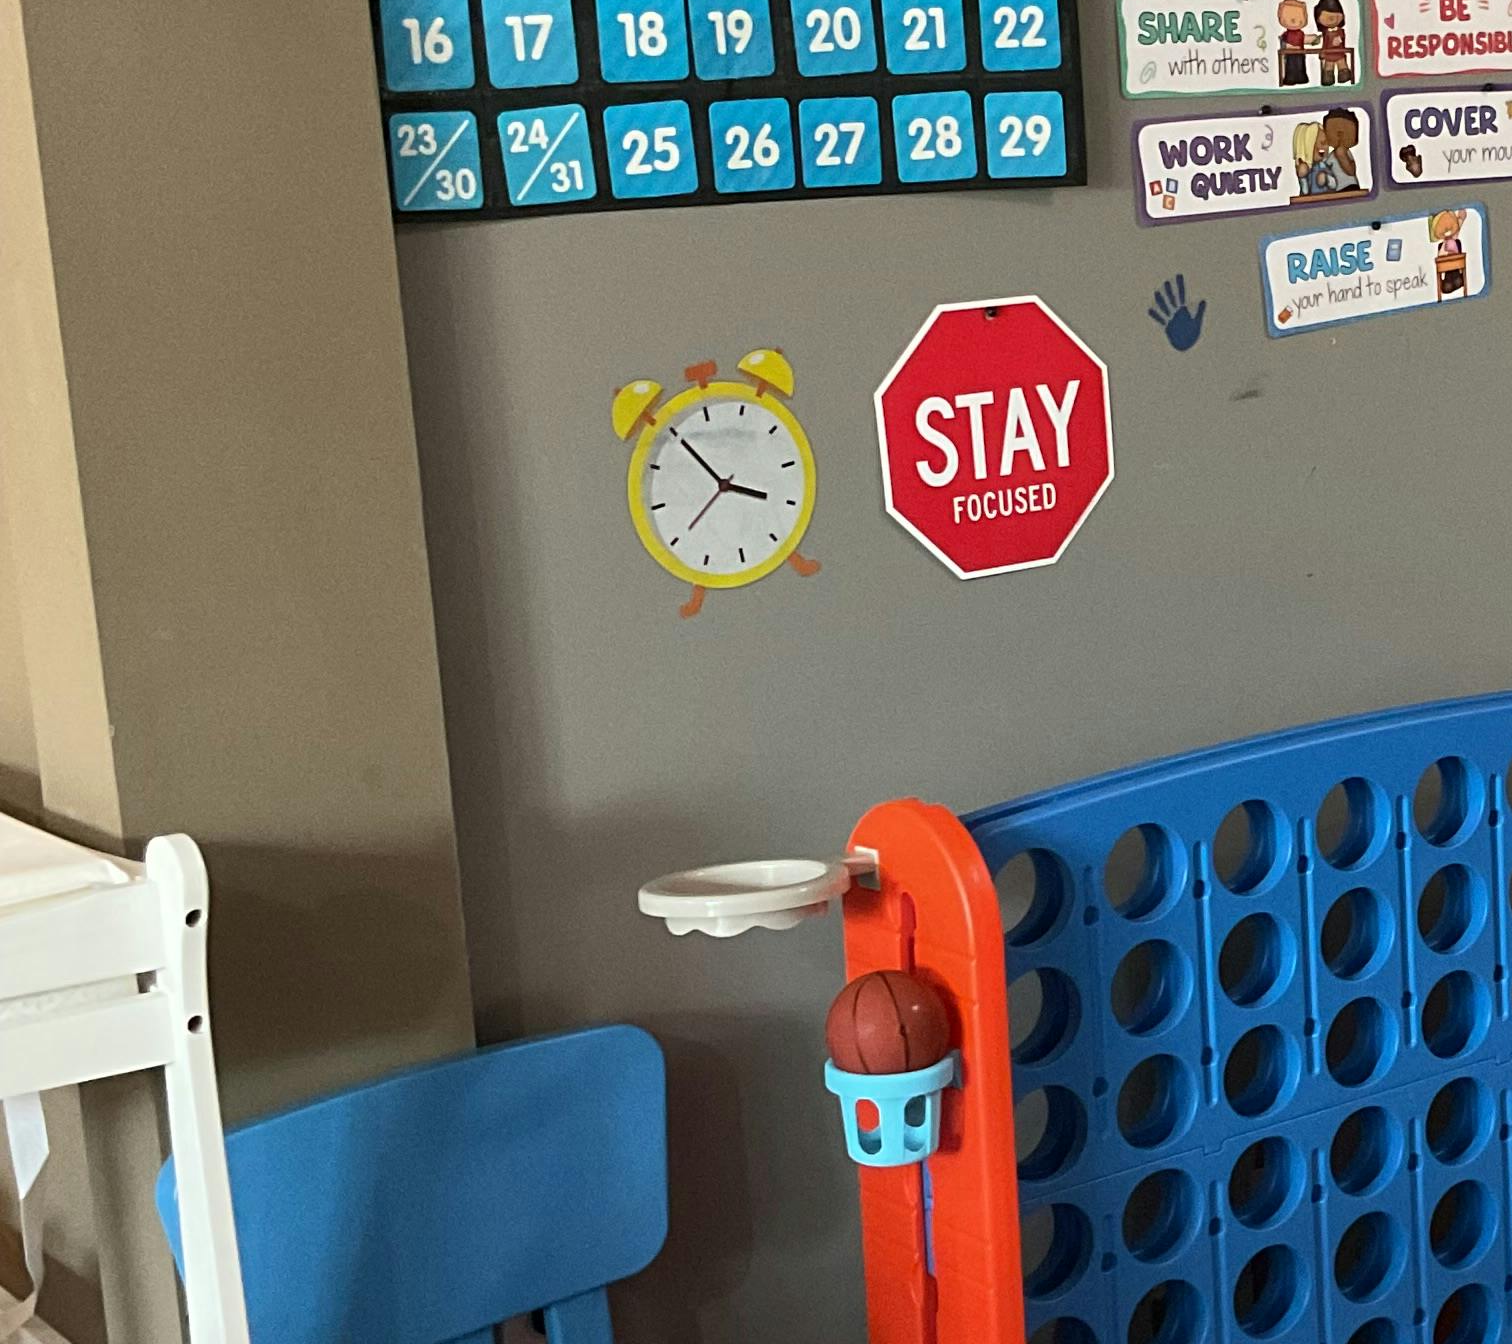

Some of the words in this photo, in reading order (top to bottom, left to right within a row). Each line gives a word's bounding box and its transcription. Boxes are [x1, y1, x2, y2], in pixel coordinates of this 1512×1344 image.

[402, 17, 454, 65] 16
[505, 14, 553, 62] 17
[617, 11, 668, 58] 18
[707, 9, 753, 55] 19
[805, 6, 862, 54] 20
[902, 7, 947, 52] 21
[992, 5, 1047, 49] 22
[1137, 10, 1243, 45] SHARE
[1167, 50, 1207, 76] with
[1211, 49, 1269, 76] others
[1404, 105, 1498, 138] COVER
[621, 126, 681, 176] 25
[724, 123, 780, 170] 26
[813, 121, 866, 167] 27
[907, 115, 962, 162] 28
[999, 115, 1052, 159] 29
[1159, 133, 1253, 169] WORK
[1442, 146, 1479, 172] your
[1190, 165, 1282, 200] QUIETLY
[1287, 239, 1375, 284] RAISE
[1292, 290, 1325, 320] your
[1327, 280, 1364, 306] hand
[1365, 278, 1383, 299] to
[1385, 272, 1429, 299] speak
[914, 379, 1081, 488] STAY
[953, 482, 1057, 524] FOCUSED
